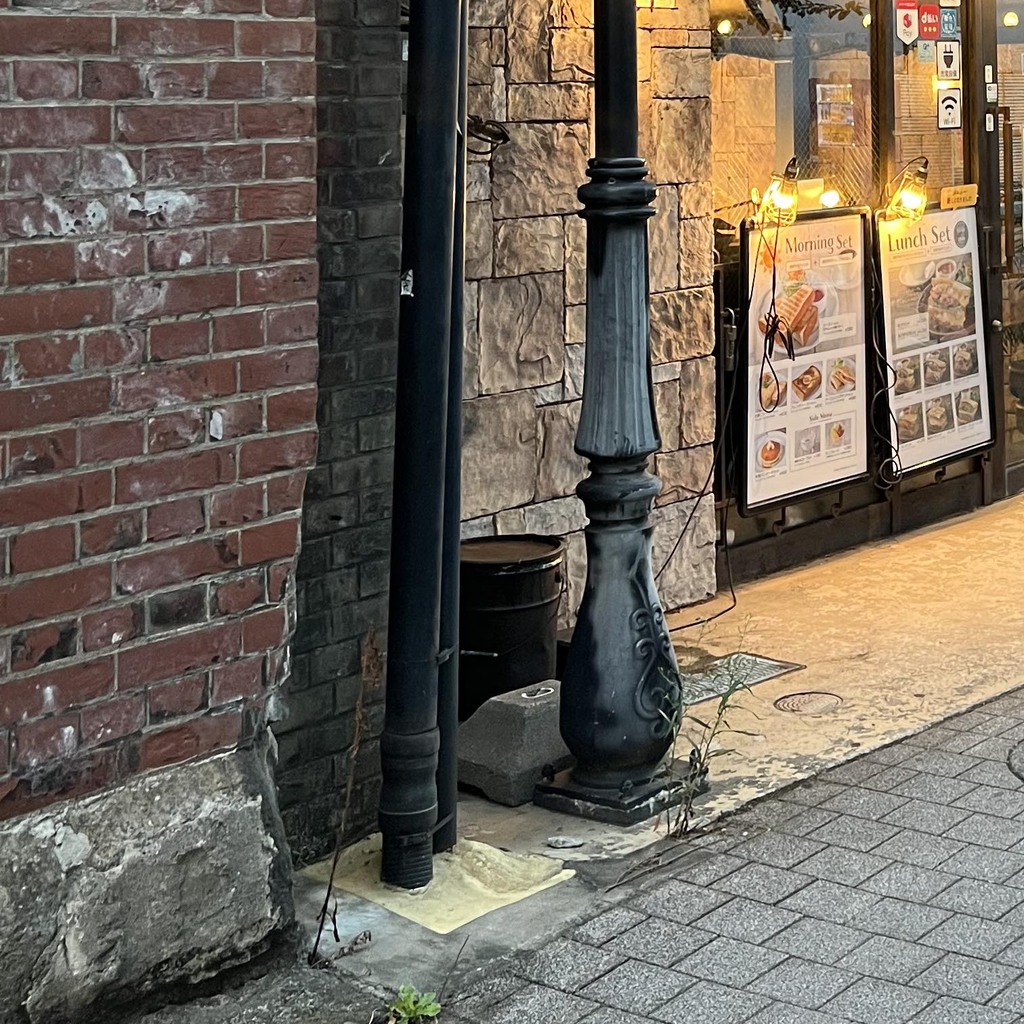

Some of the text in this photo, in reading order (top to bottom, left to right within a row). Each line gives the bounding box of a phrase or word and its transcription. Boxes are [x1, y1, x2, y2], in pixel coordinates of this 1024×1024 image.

[786, 235, 853, 254] Morning Set
[888, 225, 951, 252] Lunch Set
